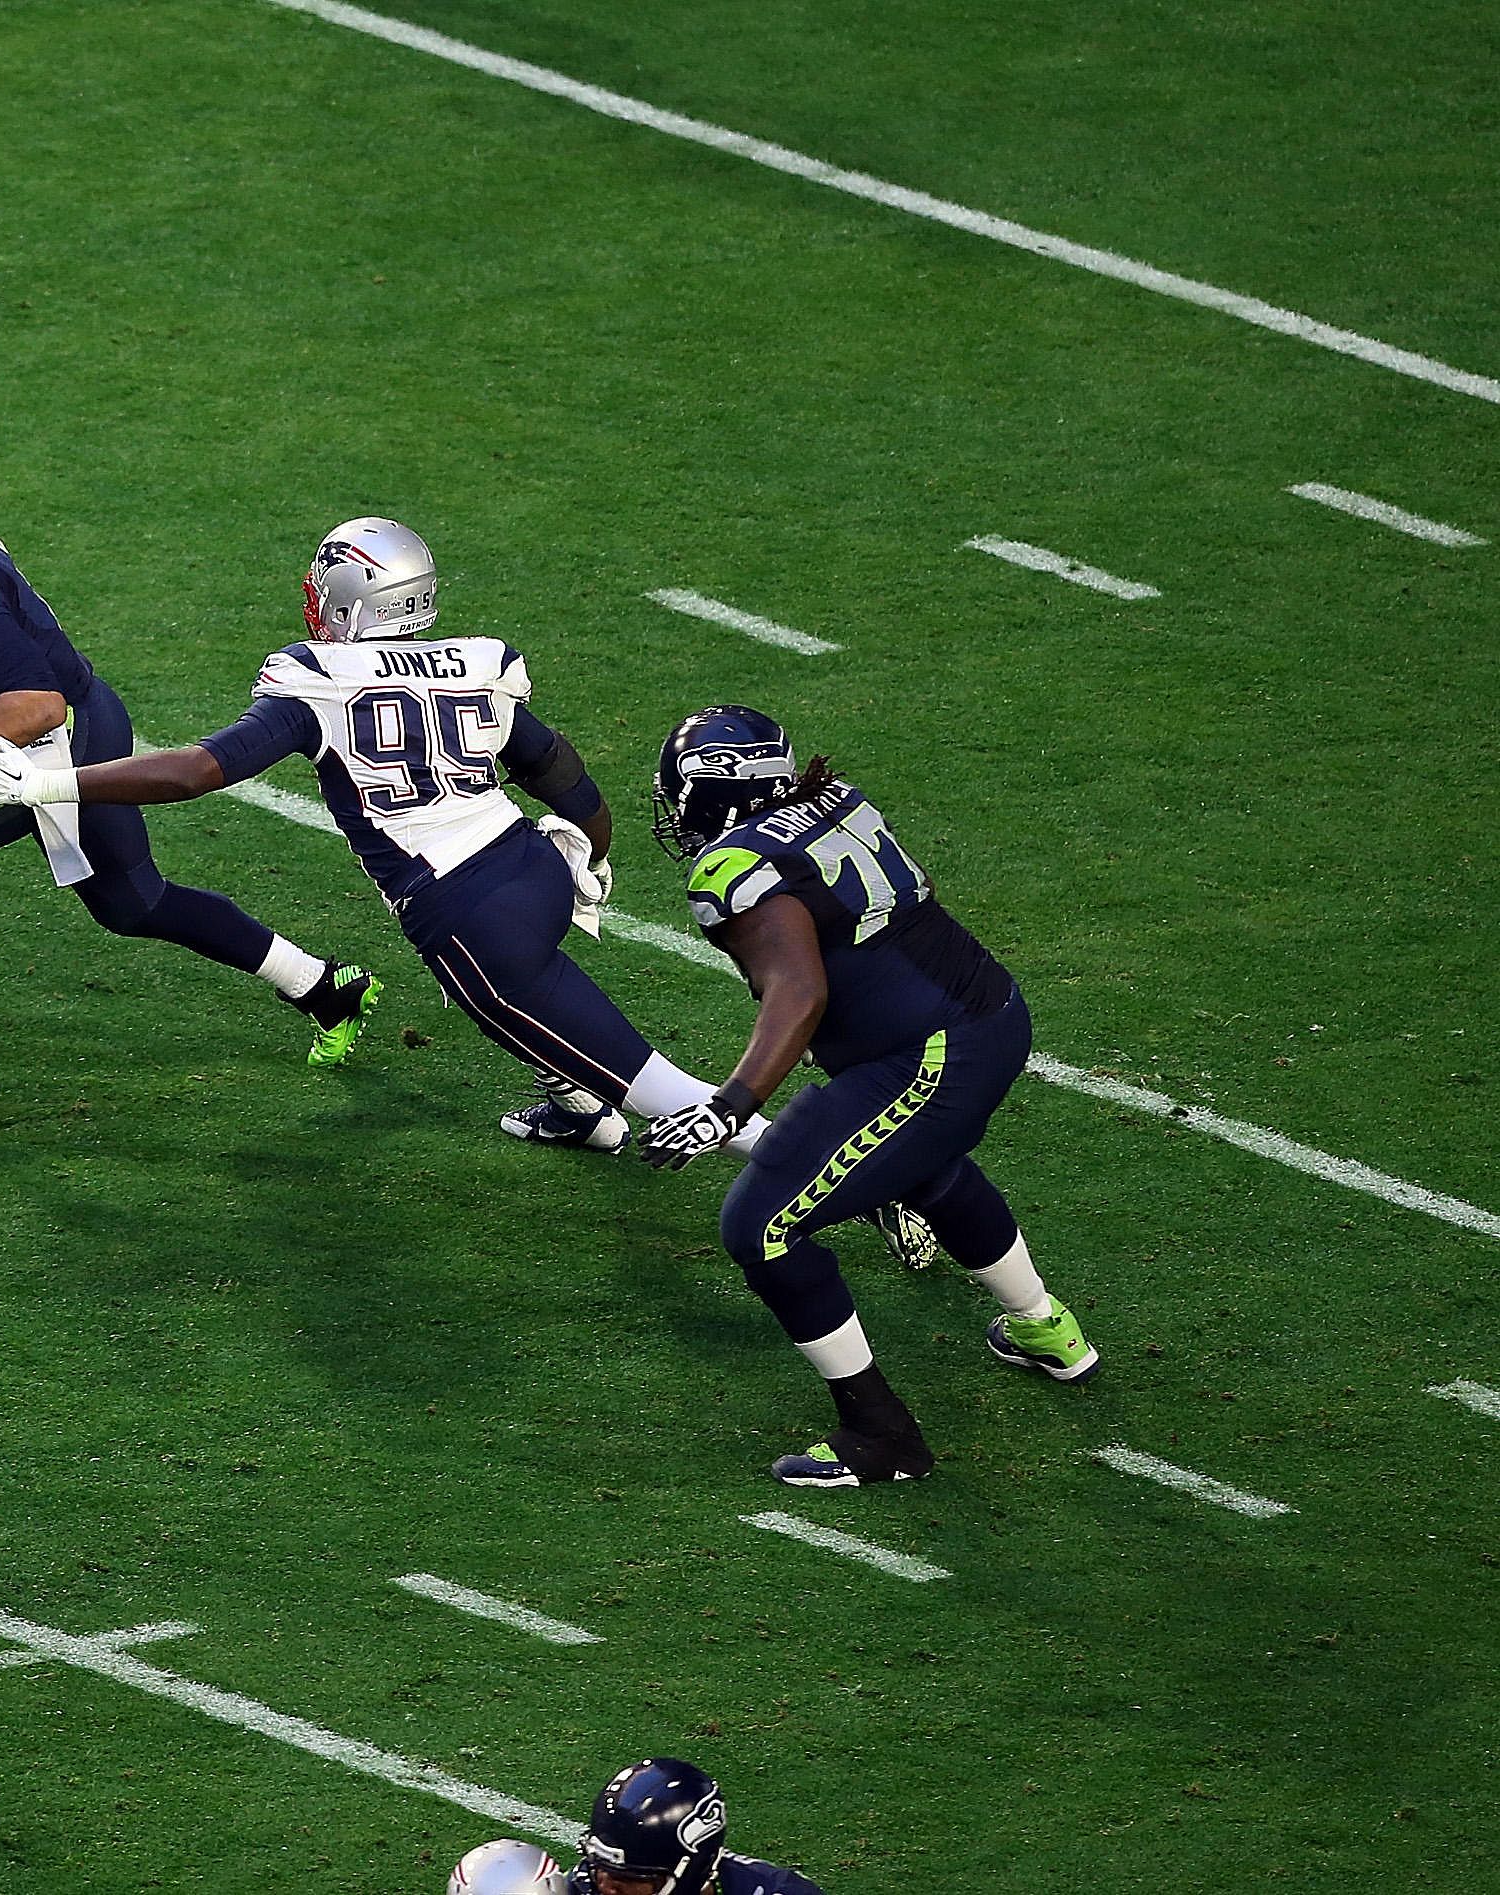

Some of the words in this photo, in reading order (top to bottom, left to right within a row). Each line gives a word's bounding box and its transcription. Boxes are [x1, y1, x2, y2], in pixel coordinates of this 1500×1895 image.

[374, 647, 467, 680] JONES
[344, 685, 501, 818] 95
[803, 799, 932, 946] 77
[333, 964, 364, 990] NIKE
